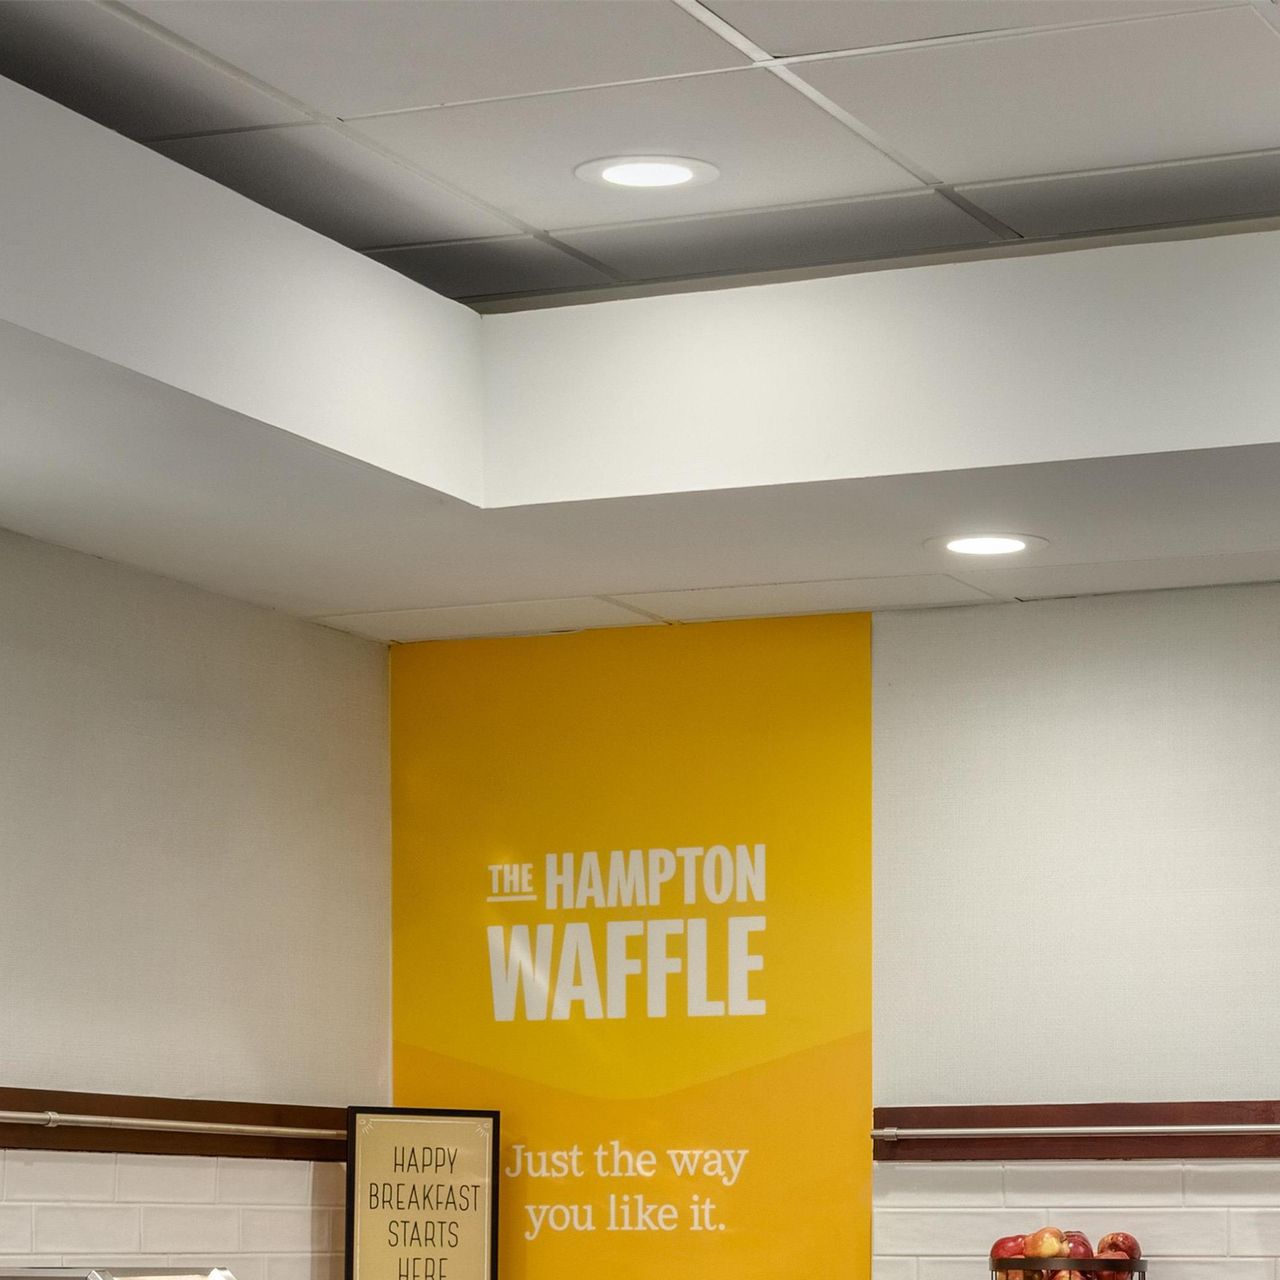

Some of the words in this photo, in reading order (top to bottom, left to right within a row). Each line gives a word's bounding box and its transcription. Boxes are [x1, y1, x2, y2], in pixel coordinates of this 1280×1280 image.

[487, 863, 536, 895] THE
[545, 843, 766, 910] HAMPTON
[486, 915, 766, 1022] WAFFLE
[393, 1146, 458, 1174] HAPPY
[504, 1143, 584, 1179] Just
[596, 1141, 658, 1179] the
[667, 1147, 750, 1187] way
[369, 1182, 481, 1212] BREAKFAST
[524, 1204, 595, 1241] you
[607, 1195, 679, 1232] like
[691, 1196, 727, 1232] it.
[388, 1220, 459, 1248] STARTS
